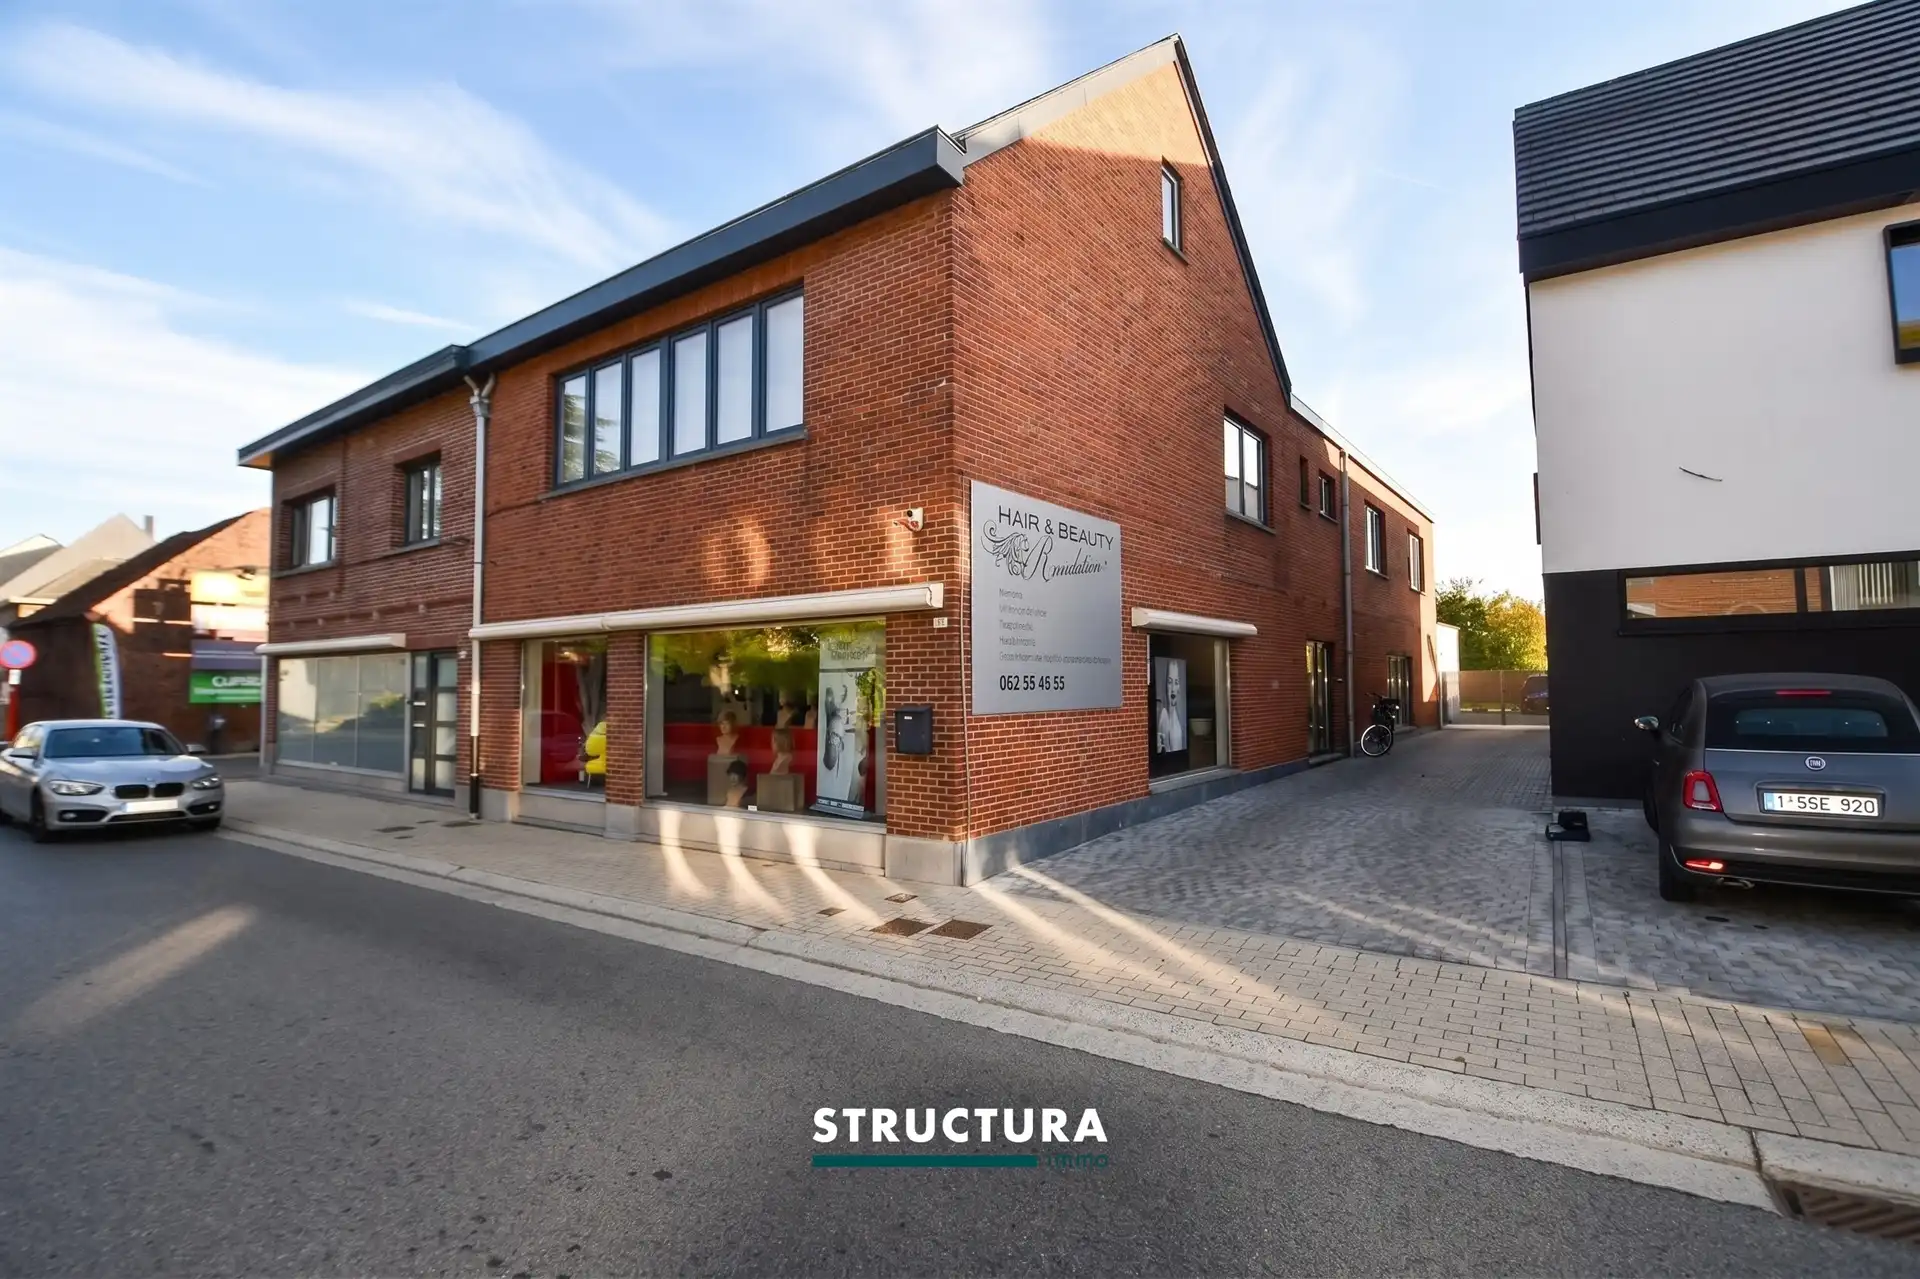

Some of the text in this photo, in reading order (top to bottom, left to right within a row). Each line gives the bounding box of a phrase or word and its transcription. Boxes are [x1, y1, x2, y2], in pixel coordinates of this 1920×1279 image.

[999, 505, 1114, 550] HAIR & BEAUTY
[999, 675, 1020, 691] 062
[1023, 675, 1036, 691] 55
[1053, 675, 1065, 691] 55
[1840, 798, 1875, 814] 920
